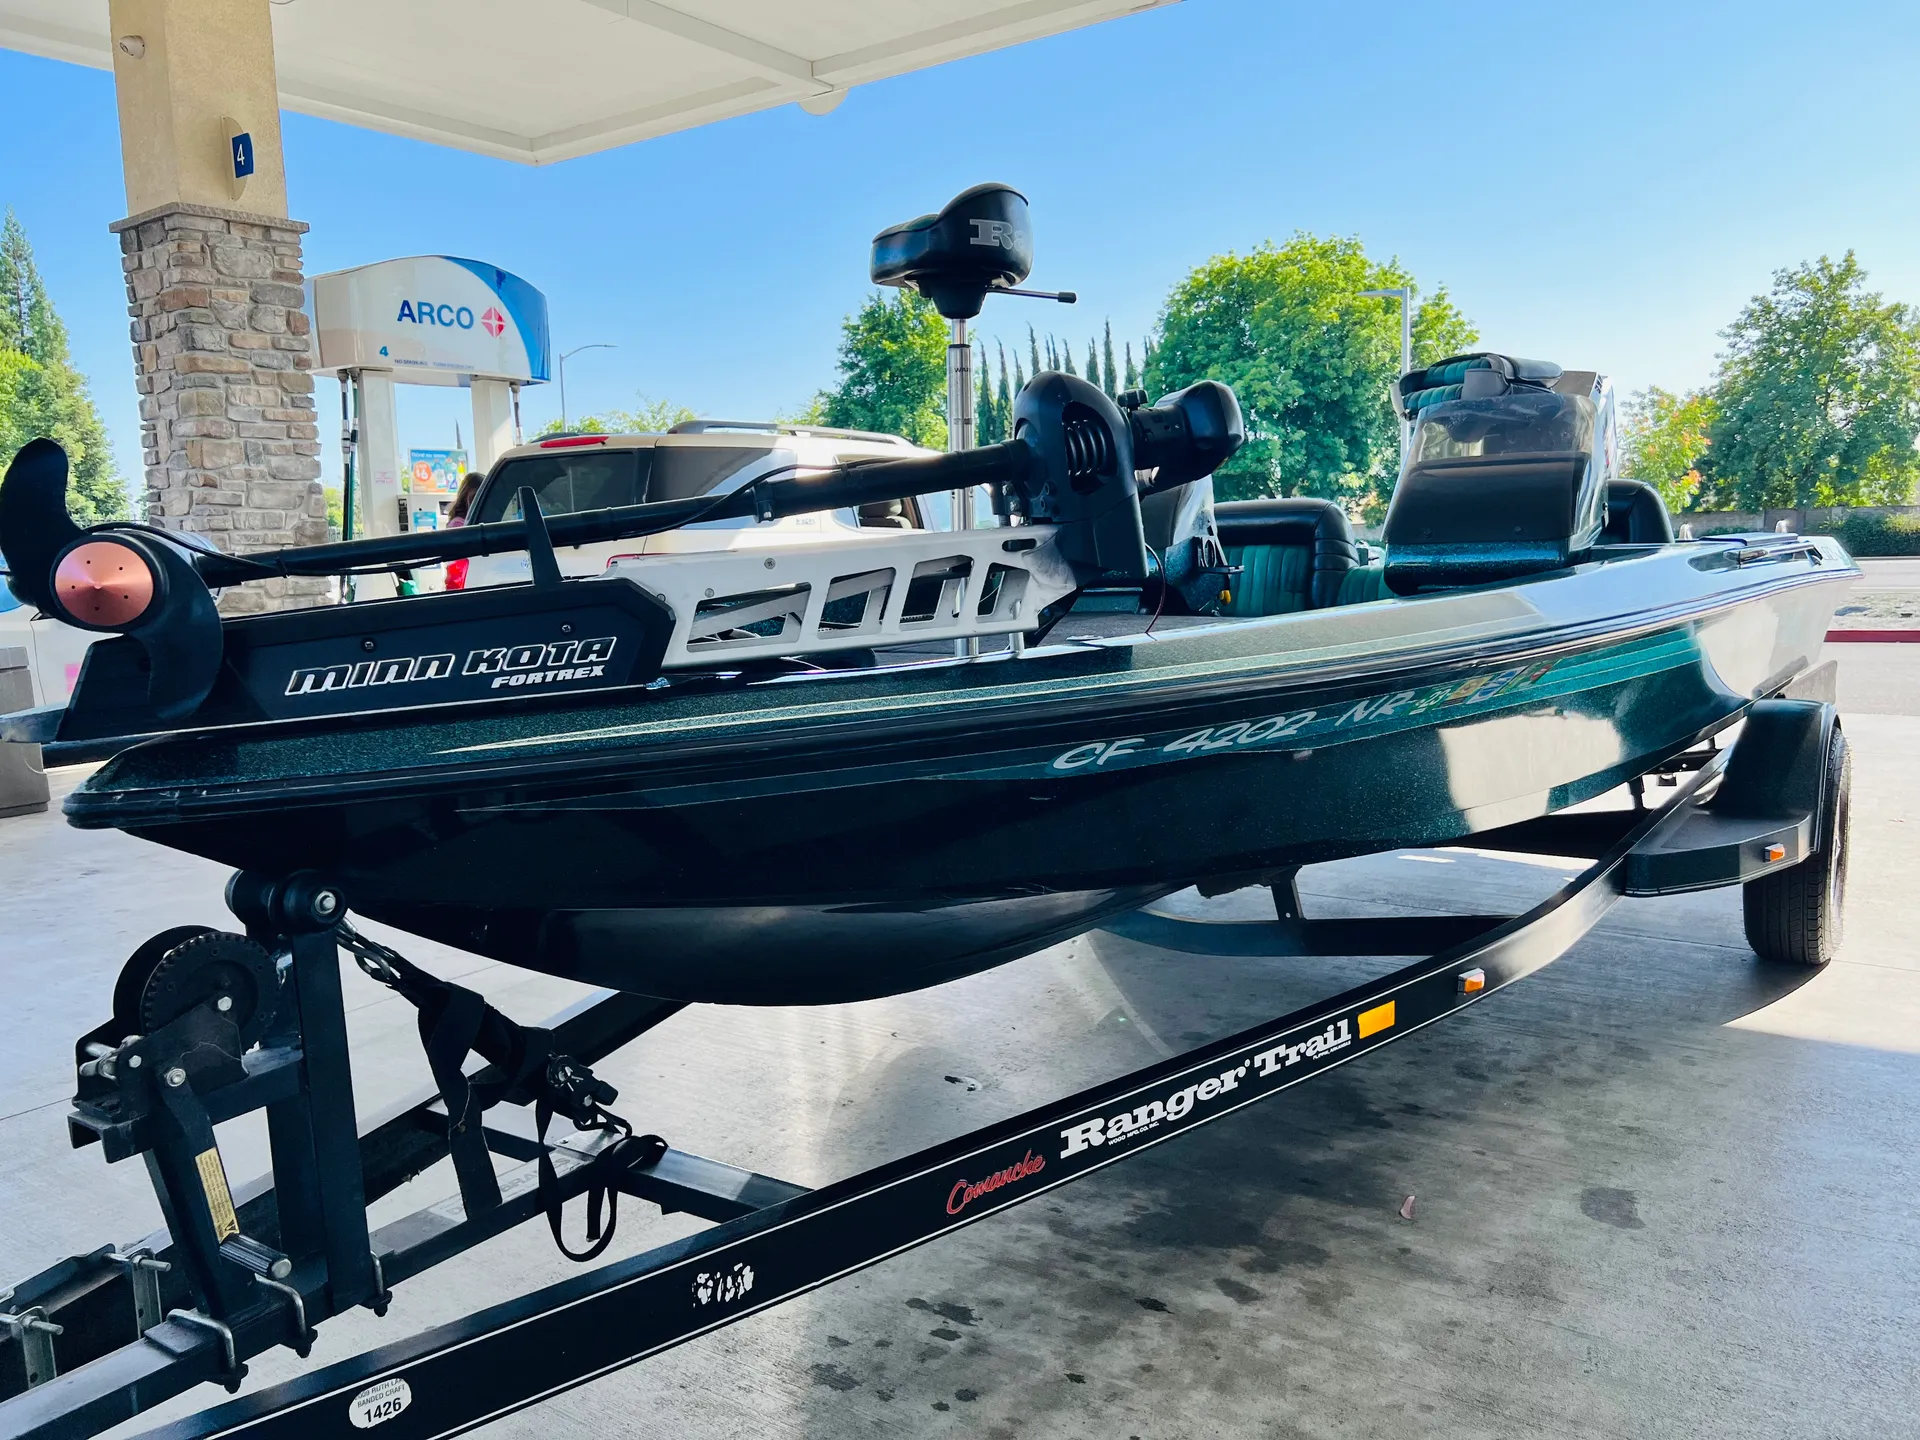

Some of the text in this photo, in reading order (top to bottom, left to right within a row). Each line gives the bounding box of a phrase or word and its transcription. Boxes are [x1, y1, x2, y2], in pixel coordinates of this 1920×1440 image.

[236, 143, 245, 166] 4
[397, 299, 474, 330] ARCO
[379, 345, 389, 357] 4
[461, 636, 617, 676] KOTA
[491, 664, 605, 689] FORTREX
[1053, 690, 1416, 770] CF 4202 NR
[1060, 1018, 1352, 1160] Ranger Trail
[1107, 1134, 1126, 1146] WOOD
[946, 1149, 1046, 1215] Comanche
[357, 1384, 406, 1408] BANDED CRAFT
[371, 1382, 390, 1395] RUTH
[364, 1397, 402, 1423] 1426
